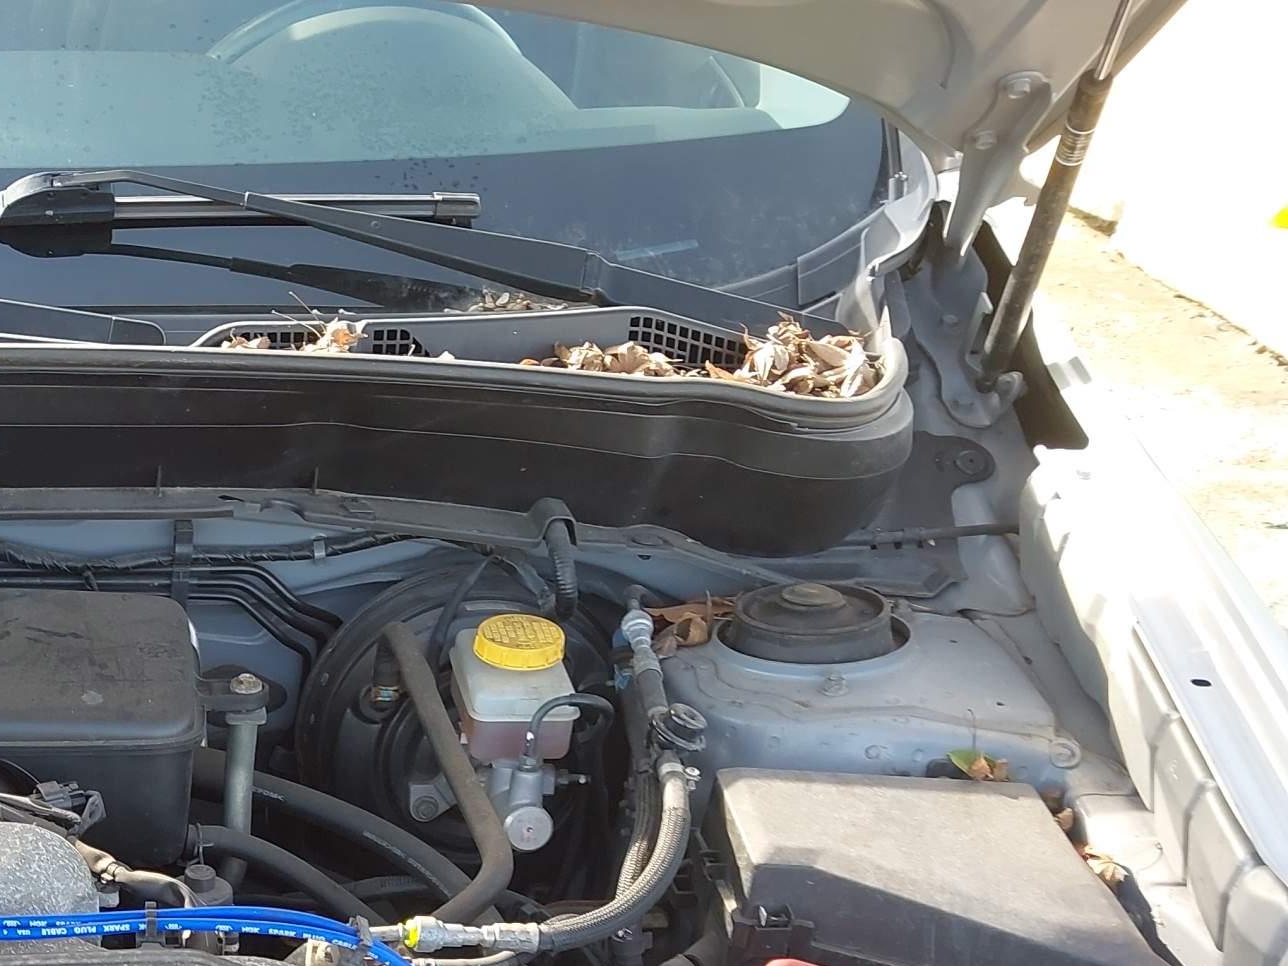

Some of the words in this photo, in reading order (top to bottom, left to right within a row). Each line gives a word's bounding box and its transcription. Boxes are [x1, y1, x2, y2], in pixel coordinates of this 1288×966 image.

[41, 927, 68, 936] CABLE
[73, 925, 97, 935] PLUG
[103, 923, 131, 933] SPARK
[268, 928, 296, 938] SPARK
[302, 932, 326, 942] PLUG
[331, 938, 358, 950] CABLE
